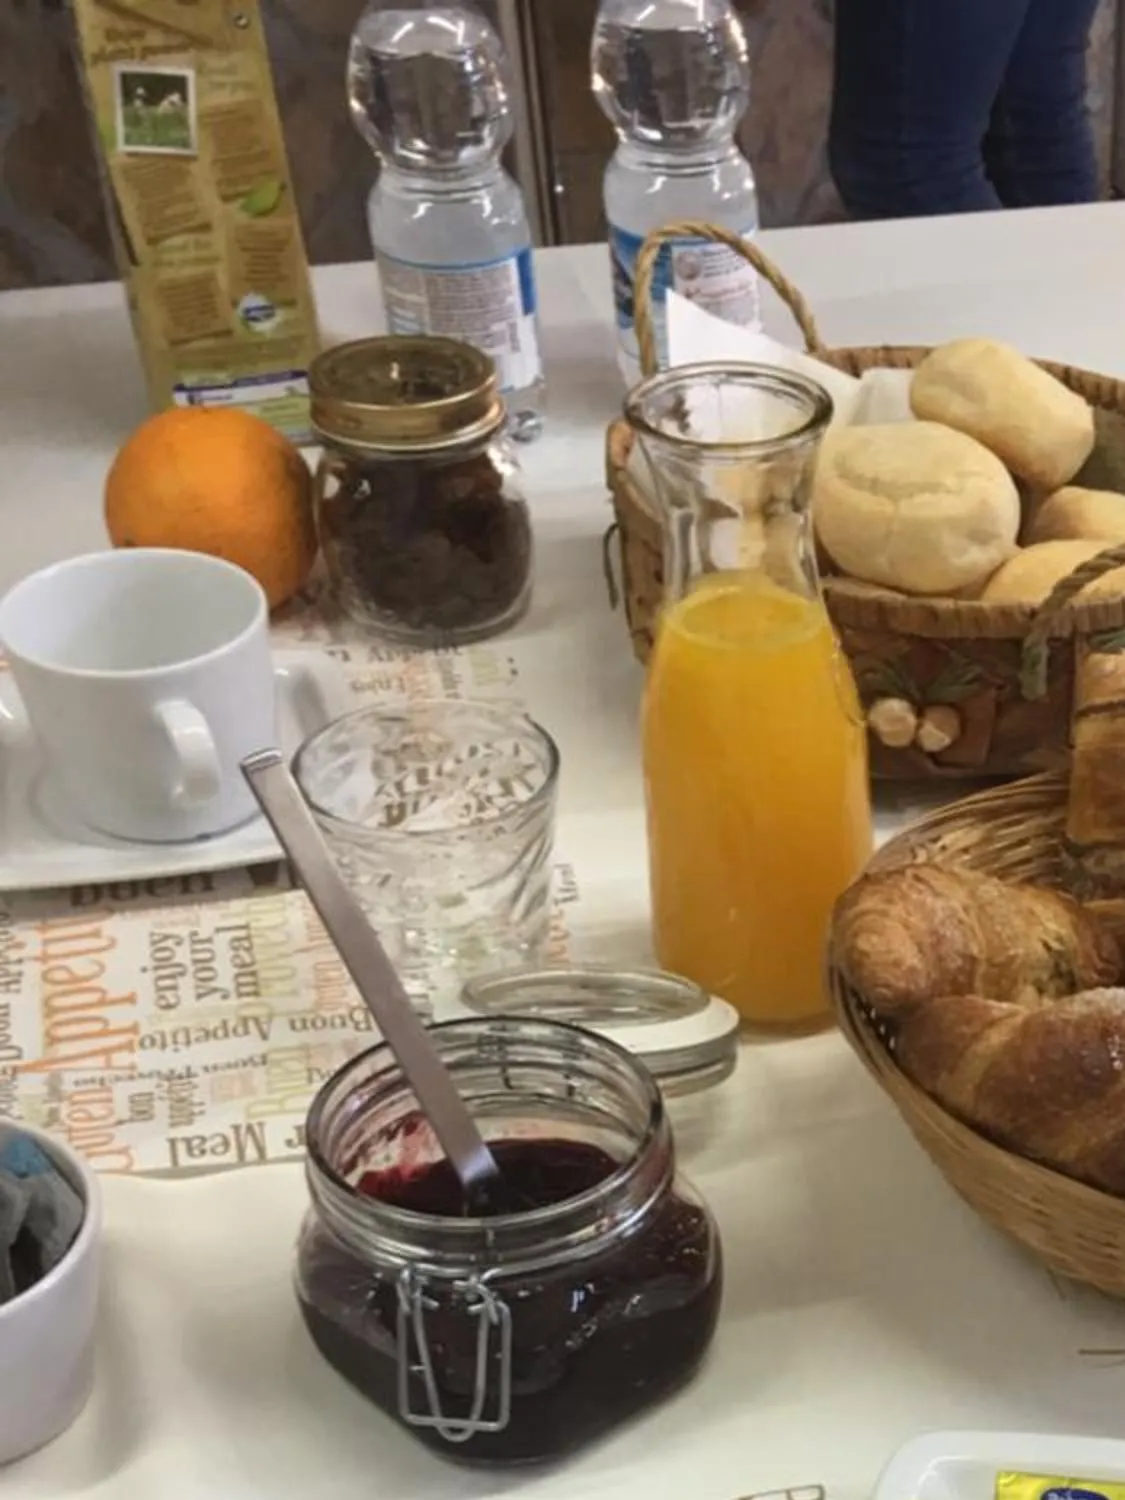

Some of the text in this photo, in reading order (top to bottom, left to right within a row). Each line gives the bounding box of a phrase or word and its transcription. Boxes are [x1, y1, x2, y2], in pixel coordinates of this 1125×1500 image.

[140, 931, 188, 1010] enjoy
[189, 930, 230, 1001] your
[215, 923, 261, 998] meal
[139, 1008, 374, 1053] Buon Appetito
[166, 1122, 267, 1168] Meal
